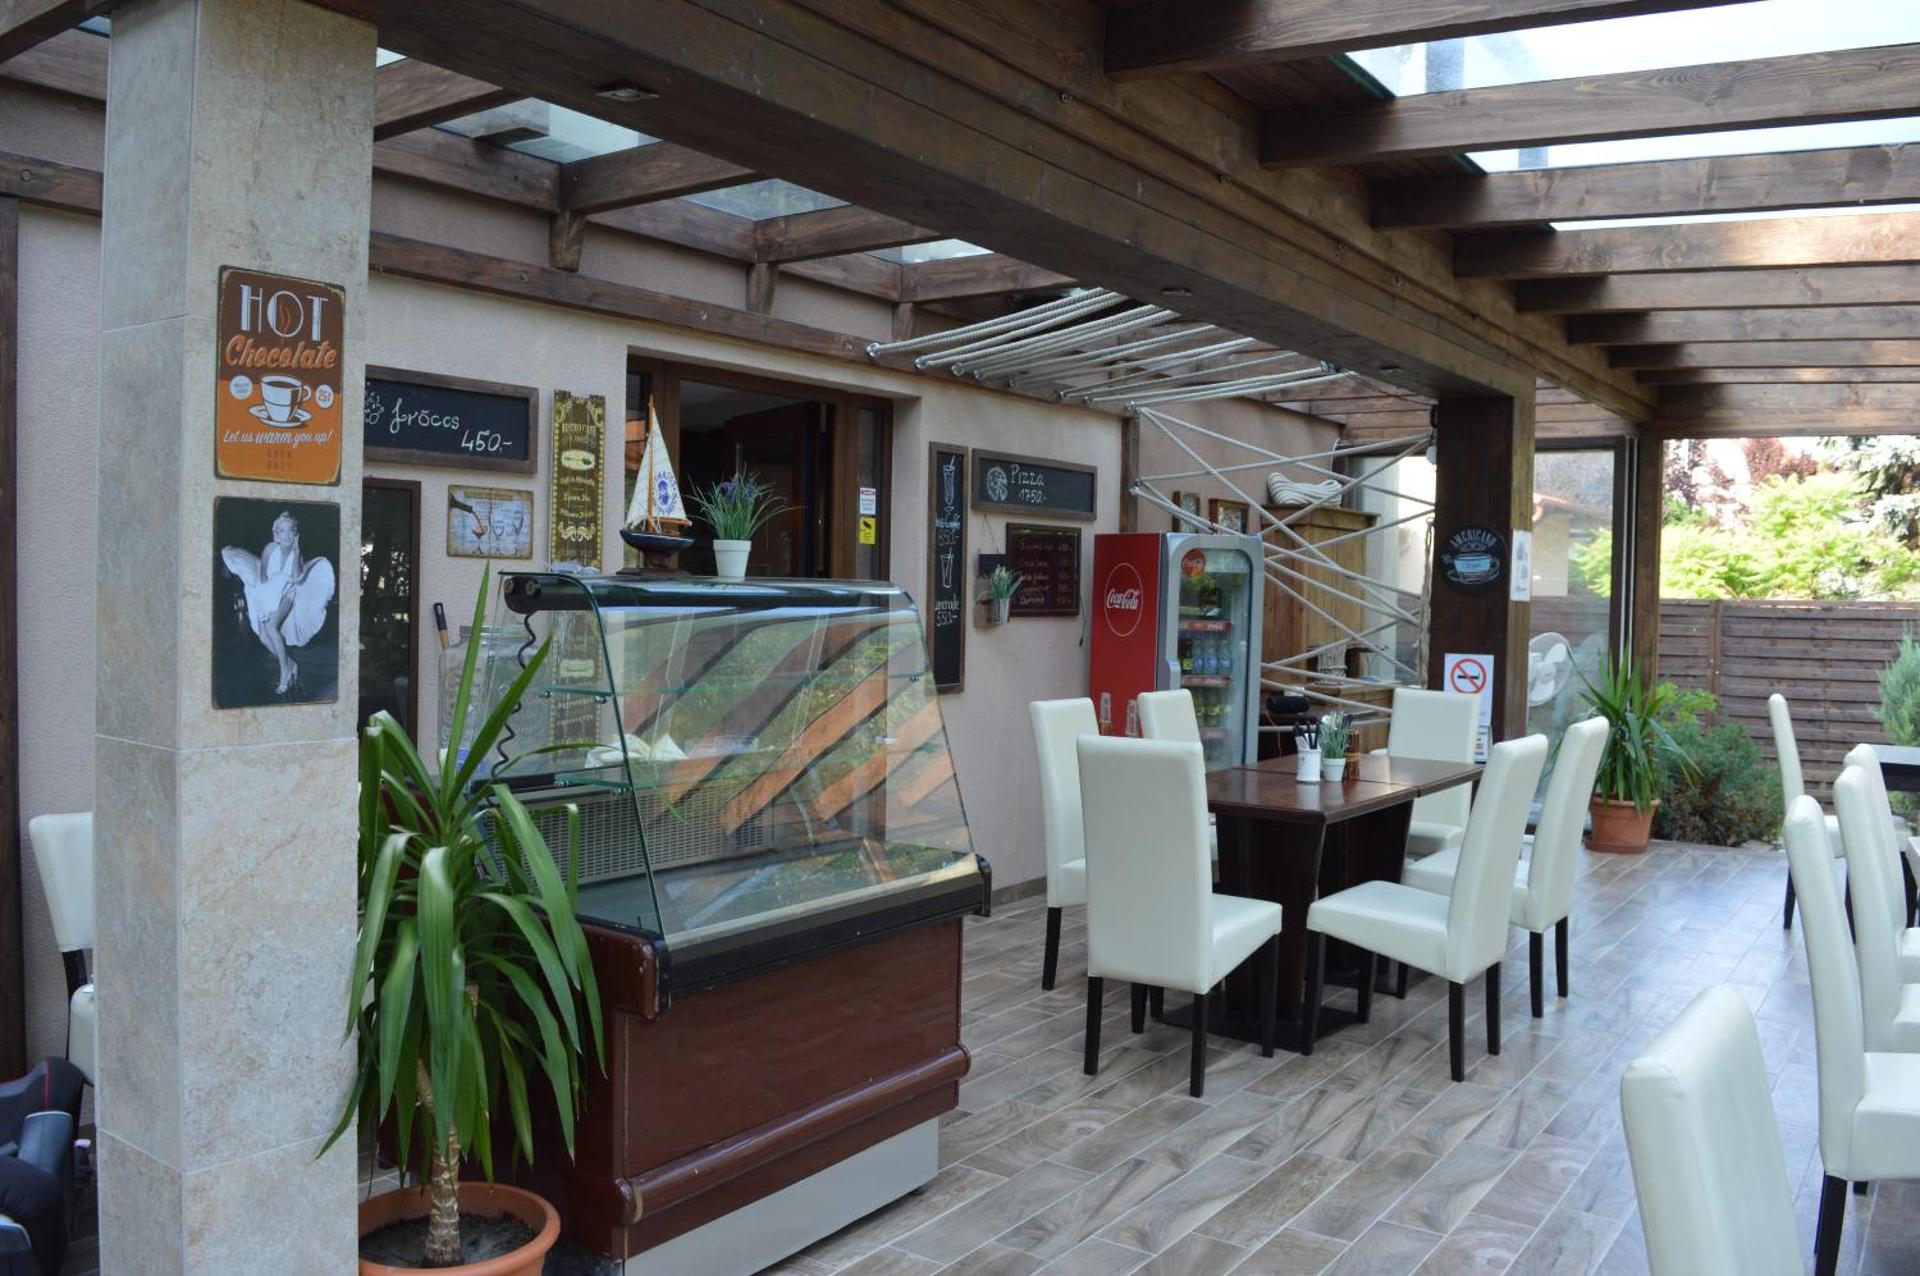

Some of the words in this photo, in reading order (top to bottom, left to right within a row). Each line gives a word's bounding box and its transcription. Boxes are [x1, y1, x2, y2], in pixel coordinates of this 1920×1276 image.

[240, 284, 329, 342] HOT
[225, 333, 337, 370] Chocolate
[223, 429, 240, 443] Let
[241, 431, 254, 442] us
[255, 431, 292, 444] warm
[292, 431, 312, 449] you
[314, 428, 334, 445] up!
[1009, 463, 1044, 487] Pizza
[1106, 588, 1141, 610] Coca-Cola
